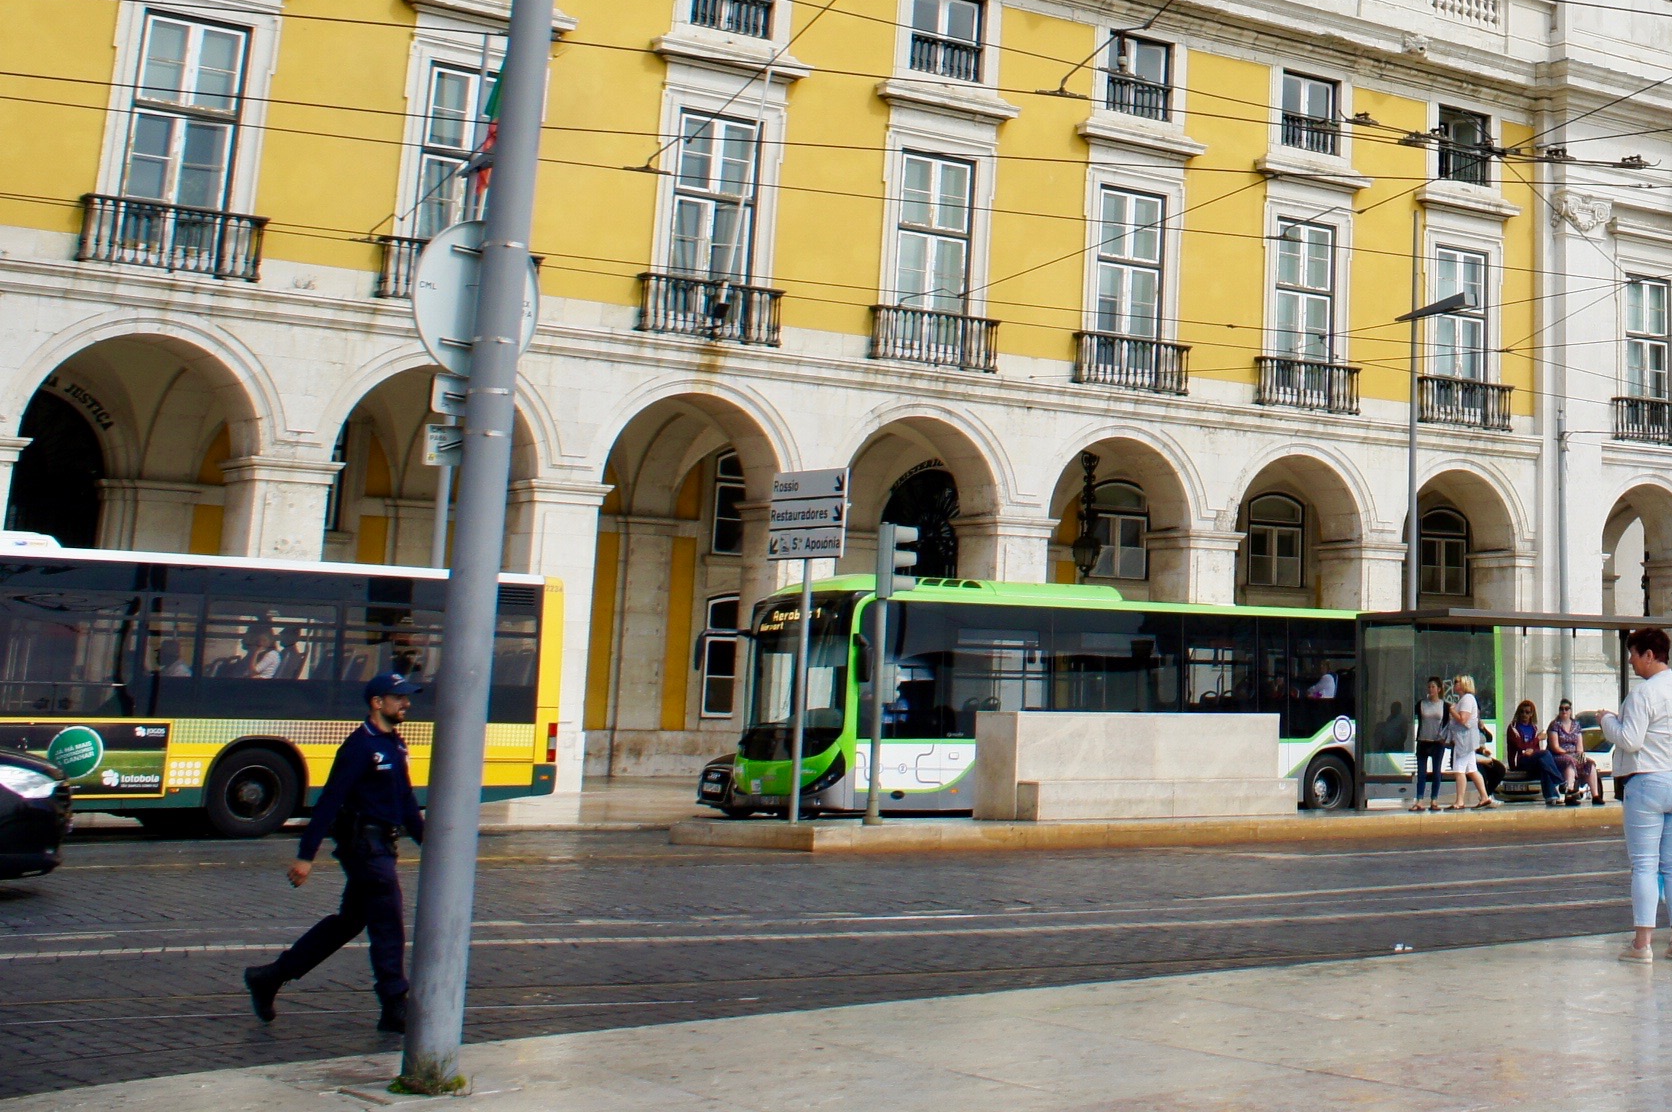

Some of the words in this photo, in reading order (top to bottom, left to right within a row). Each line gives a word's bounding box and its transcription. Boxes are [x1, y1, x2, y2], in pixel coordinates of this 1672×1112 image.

[419, 280, 437, 290] CML
[774, 479, 799, 492] Rossio
[770, 507, 828, 522] Restauradores
[804, 536, 840, 552] Apolónia
[772, 608, 812, 622] Aerobs
[816, 607, 822, 619] 1
[74, 740, 93, 750] MAIS
[63, 751, 95, 765] GANHAR
[120, 774, 160, 783] totobola
